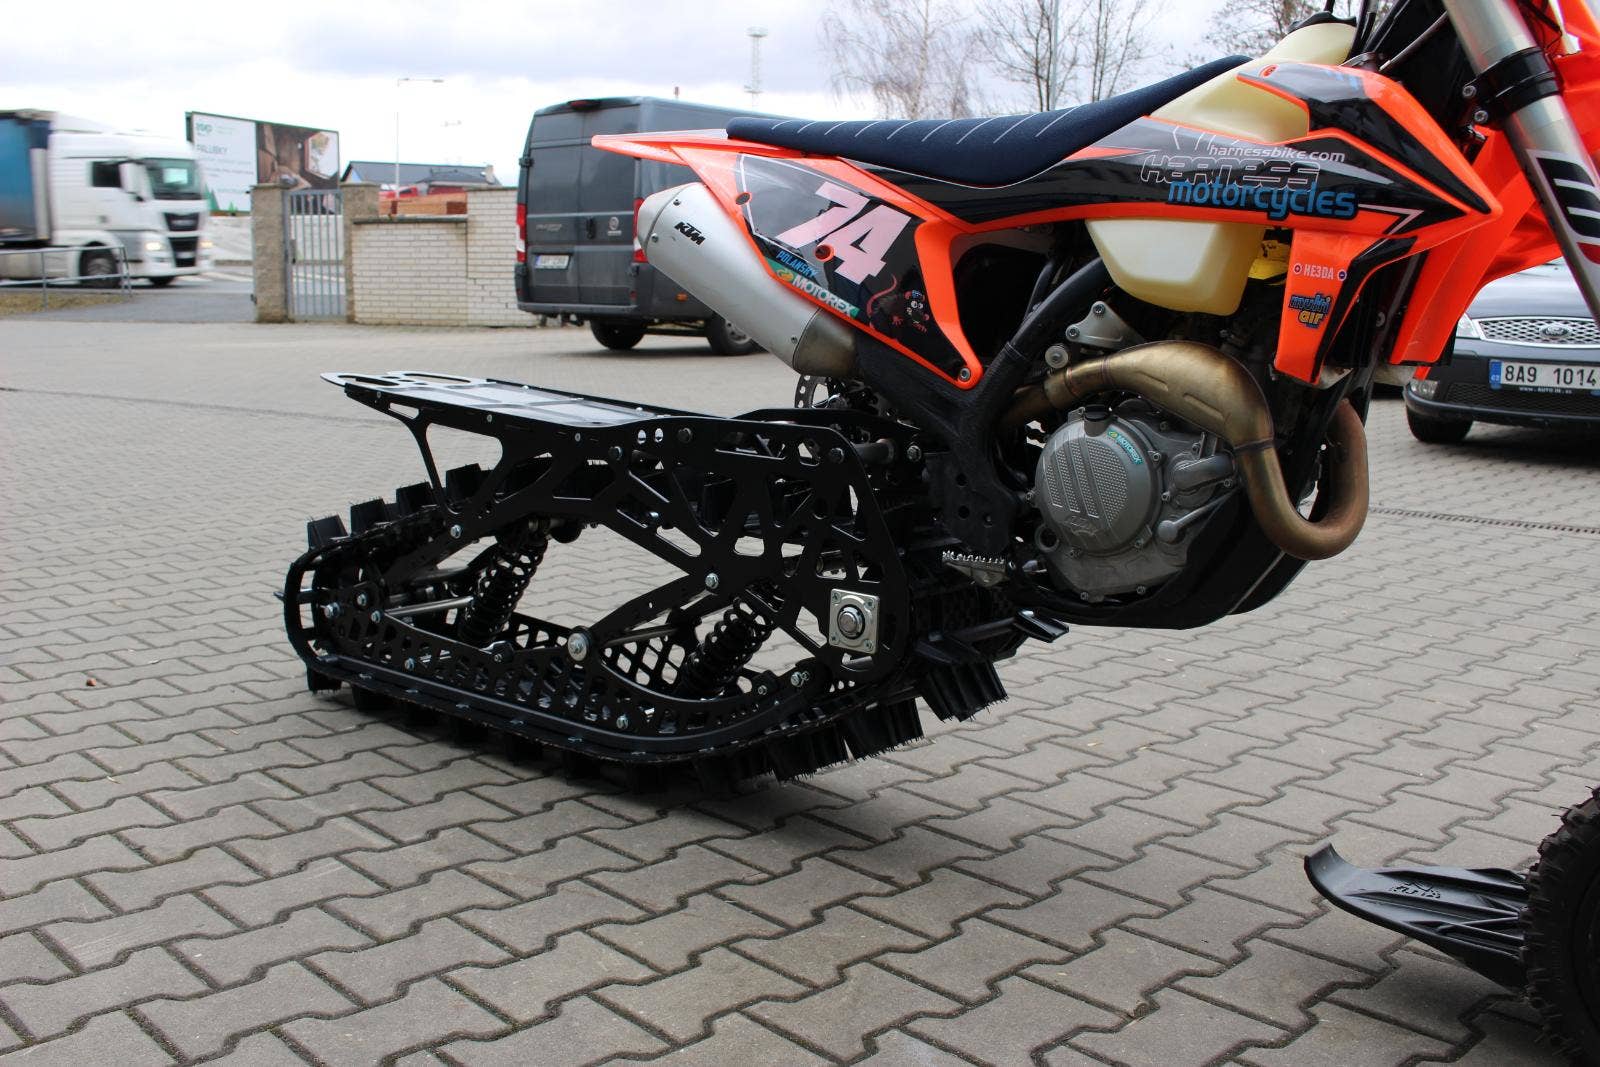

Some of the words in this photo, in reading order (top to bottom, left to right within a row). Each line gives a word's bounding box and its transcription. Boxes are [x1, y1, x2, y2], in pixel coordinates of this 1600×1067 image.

[1208, 144, 1345, 163] harnessbike.com
[1168, 176, 1356, 218] motorcycles
[674, 221, 706, 246] KTM
[775, 181, 912, 285] 74
[1303, 263, 1335, 280] HE3DA
[792, 274, 856, 317] MOTOREX
[1299, 311, 1324, 325] air
[1504, 364, 1538, 383] 8A9
[1553, 367, 1598, 387] 1014
[1117, 434, 1142, 464] MOTOREX
